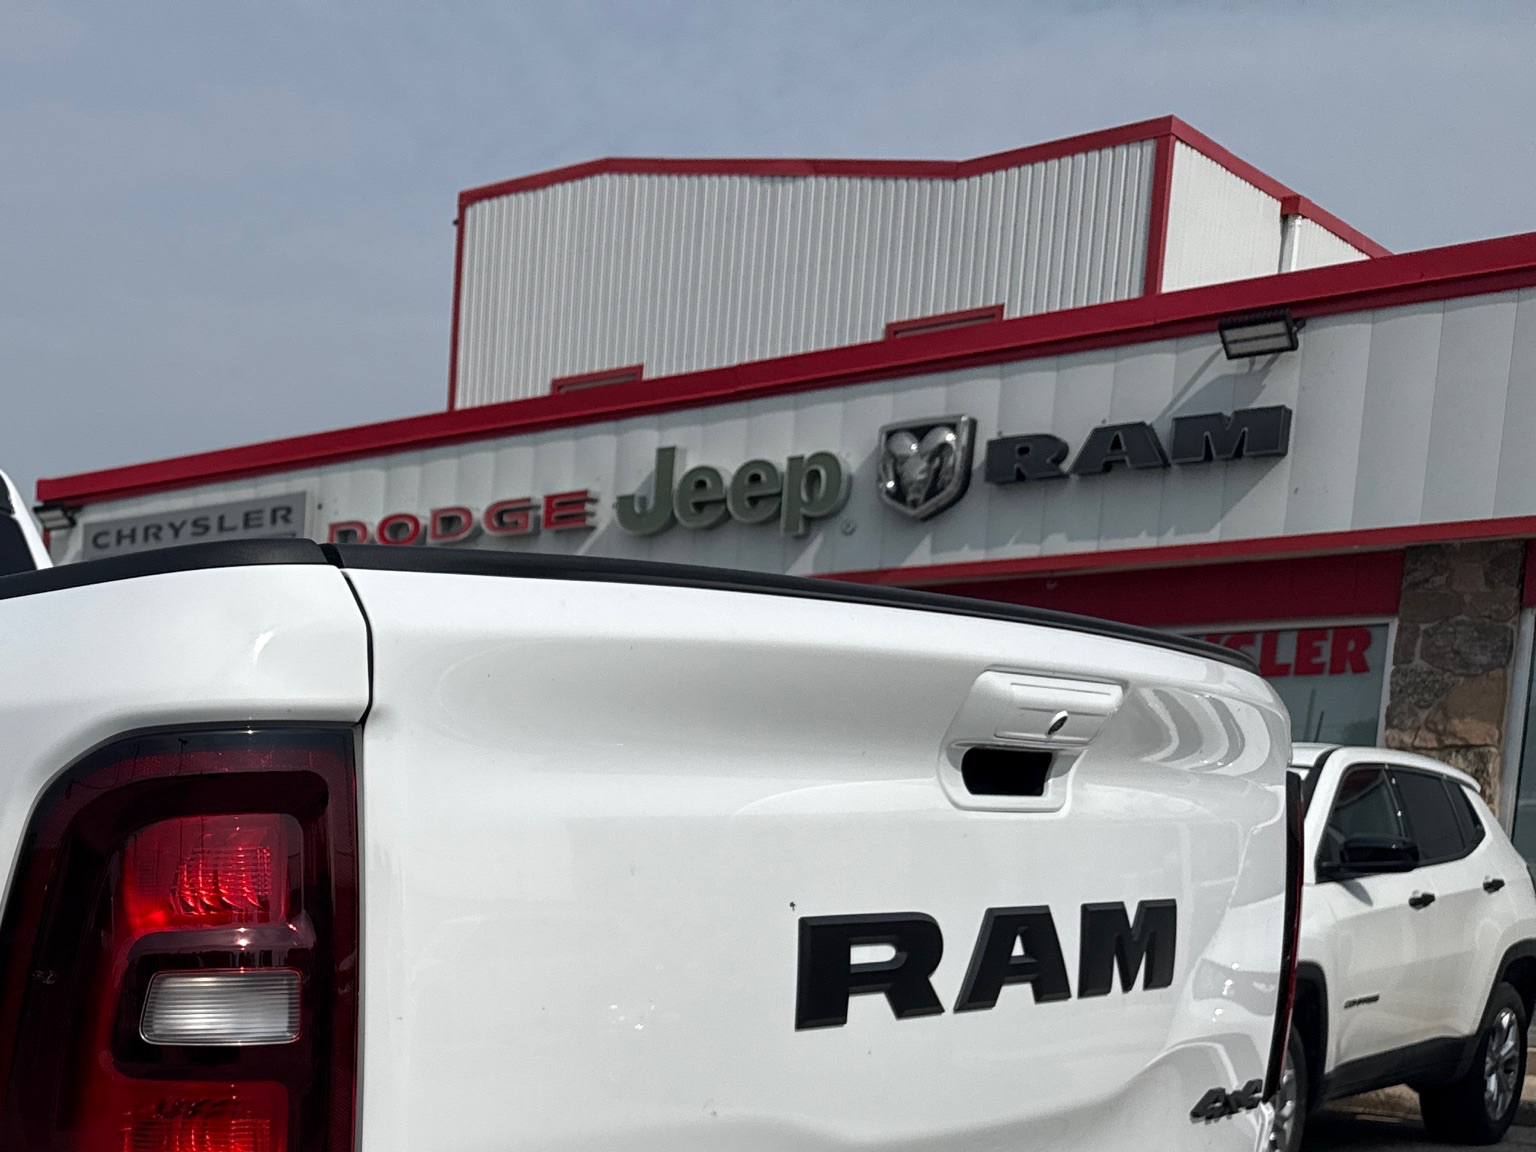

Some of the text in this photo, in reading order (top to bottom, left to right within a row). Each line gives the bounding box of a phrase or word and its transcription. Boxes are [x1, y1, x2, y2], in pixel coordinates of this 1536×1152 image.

[985, 405, 1292, 484] RAM
[91, 505, 294, 550] CHRYSLER
[327, 490, 591, 545] DODGE
[616, 446, 845, 537] Jeep
[795, 898, 1178, 1031] RAM
